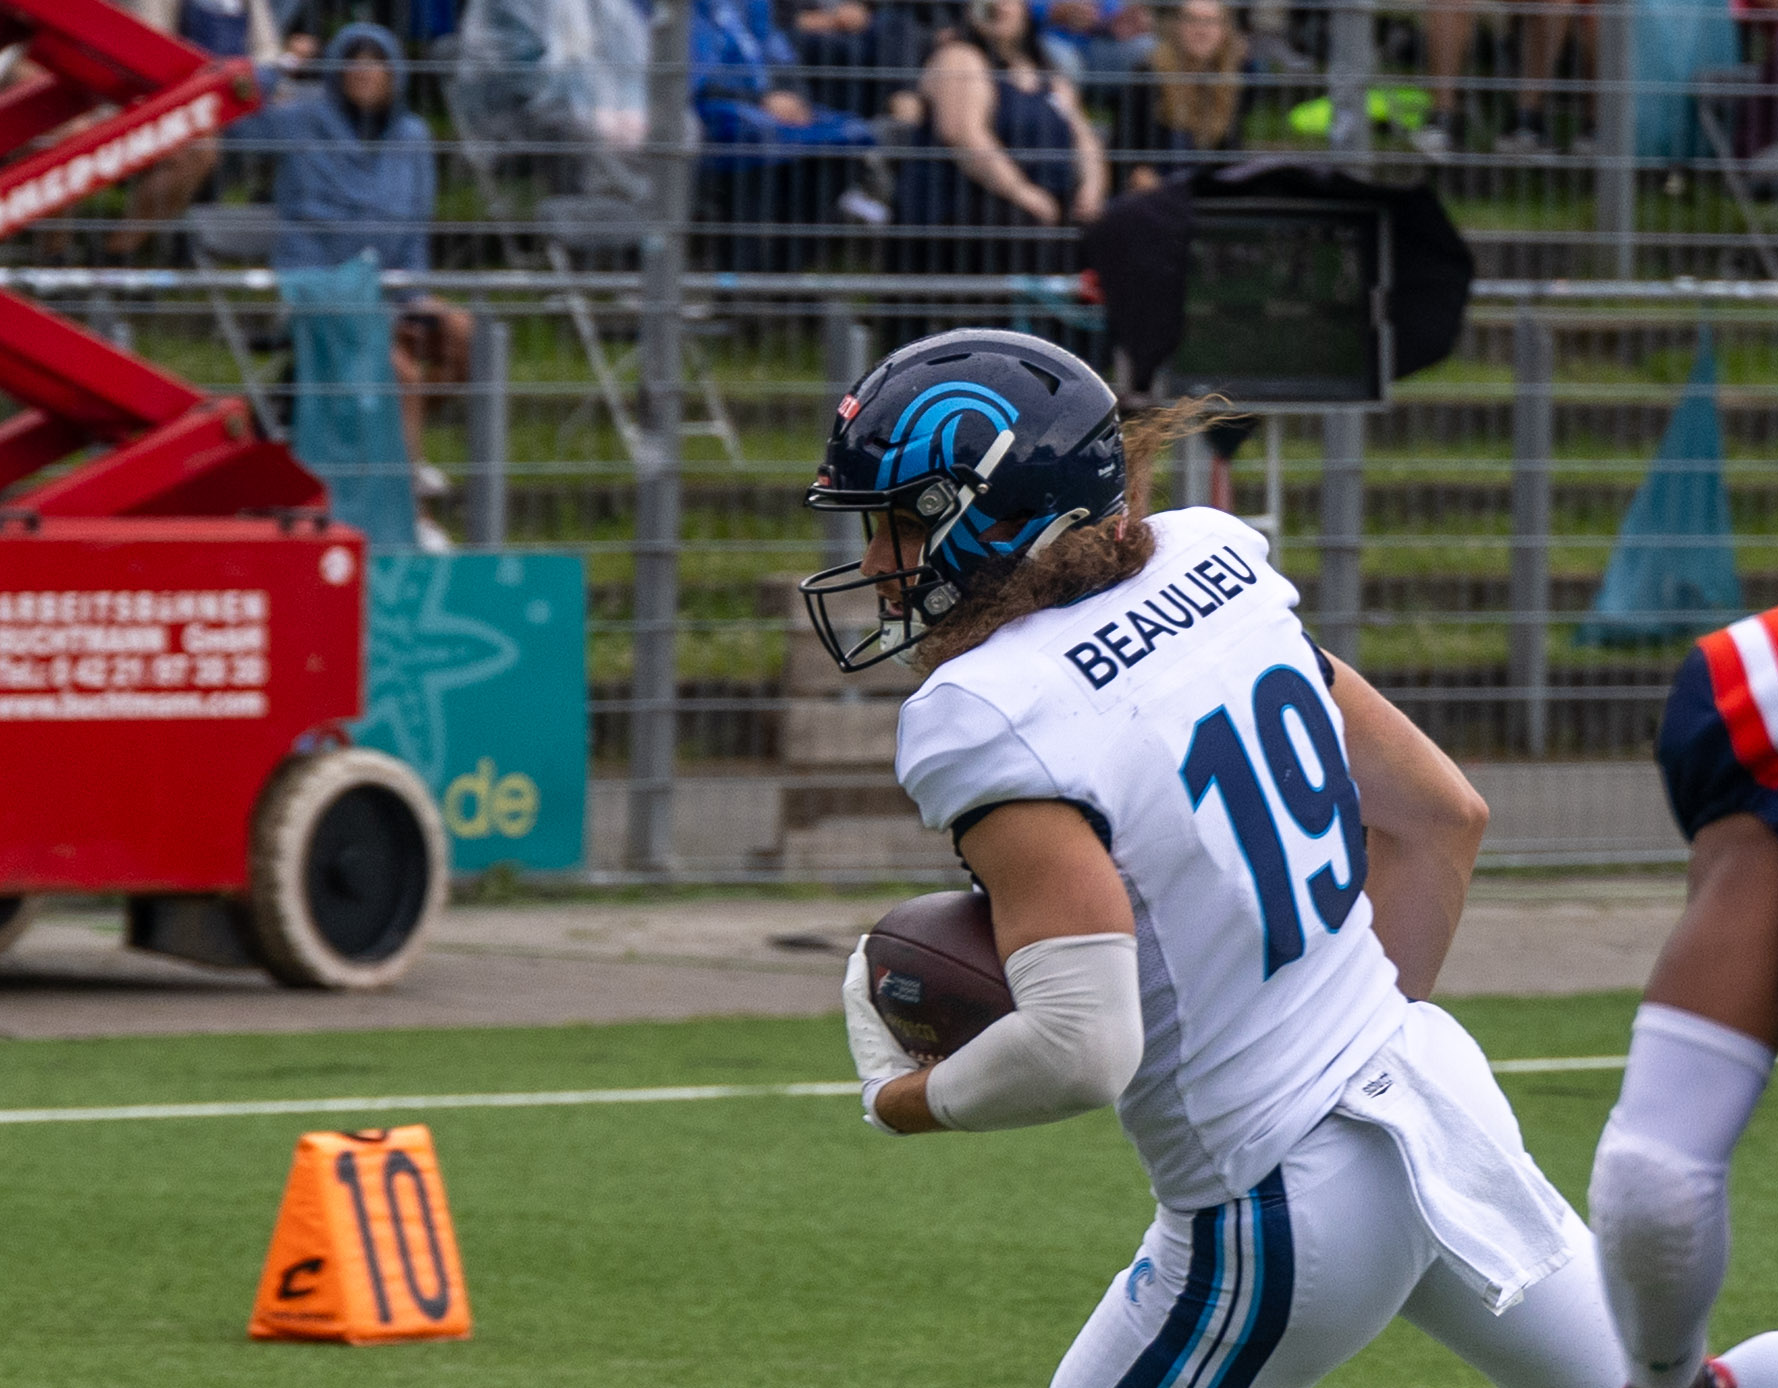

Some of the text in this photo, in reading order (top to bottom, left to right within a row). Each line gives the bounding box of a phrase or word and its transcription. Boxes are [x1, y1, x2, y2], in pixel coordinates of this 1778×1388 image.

[1063, 545, 1258, 691] BEAULIEU
[1178, 663, 1369, 982] 19
[337, 1151, 449, 1323] 10
